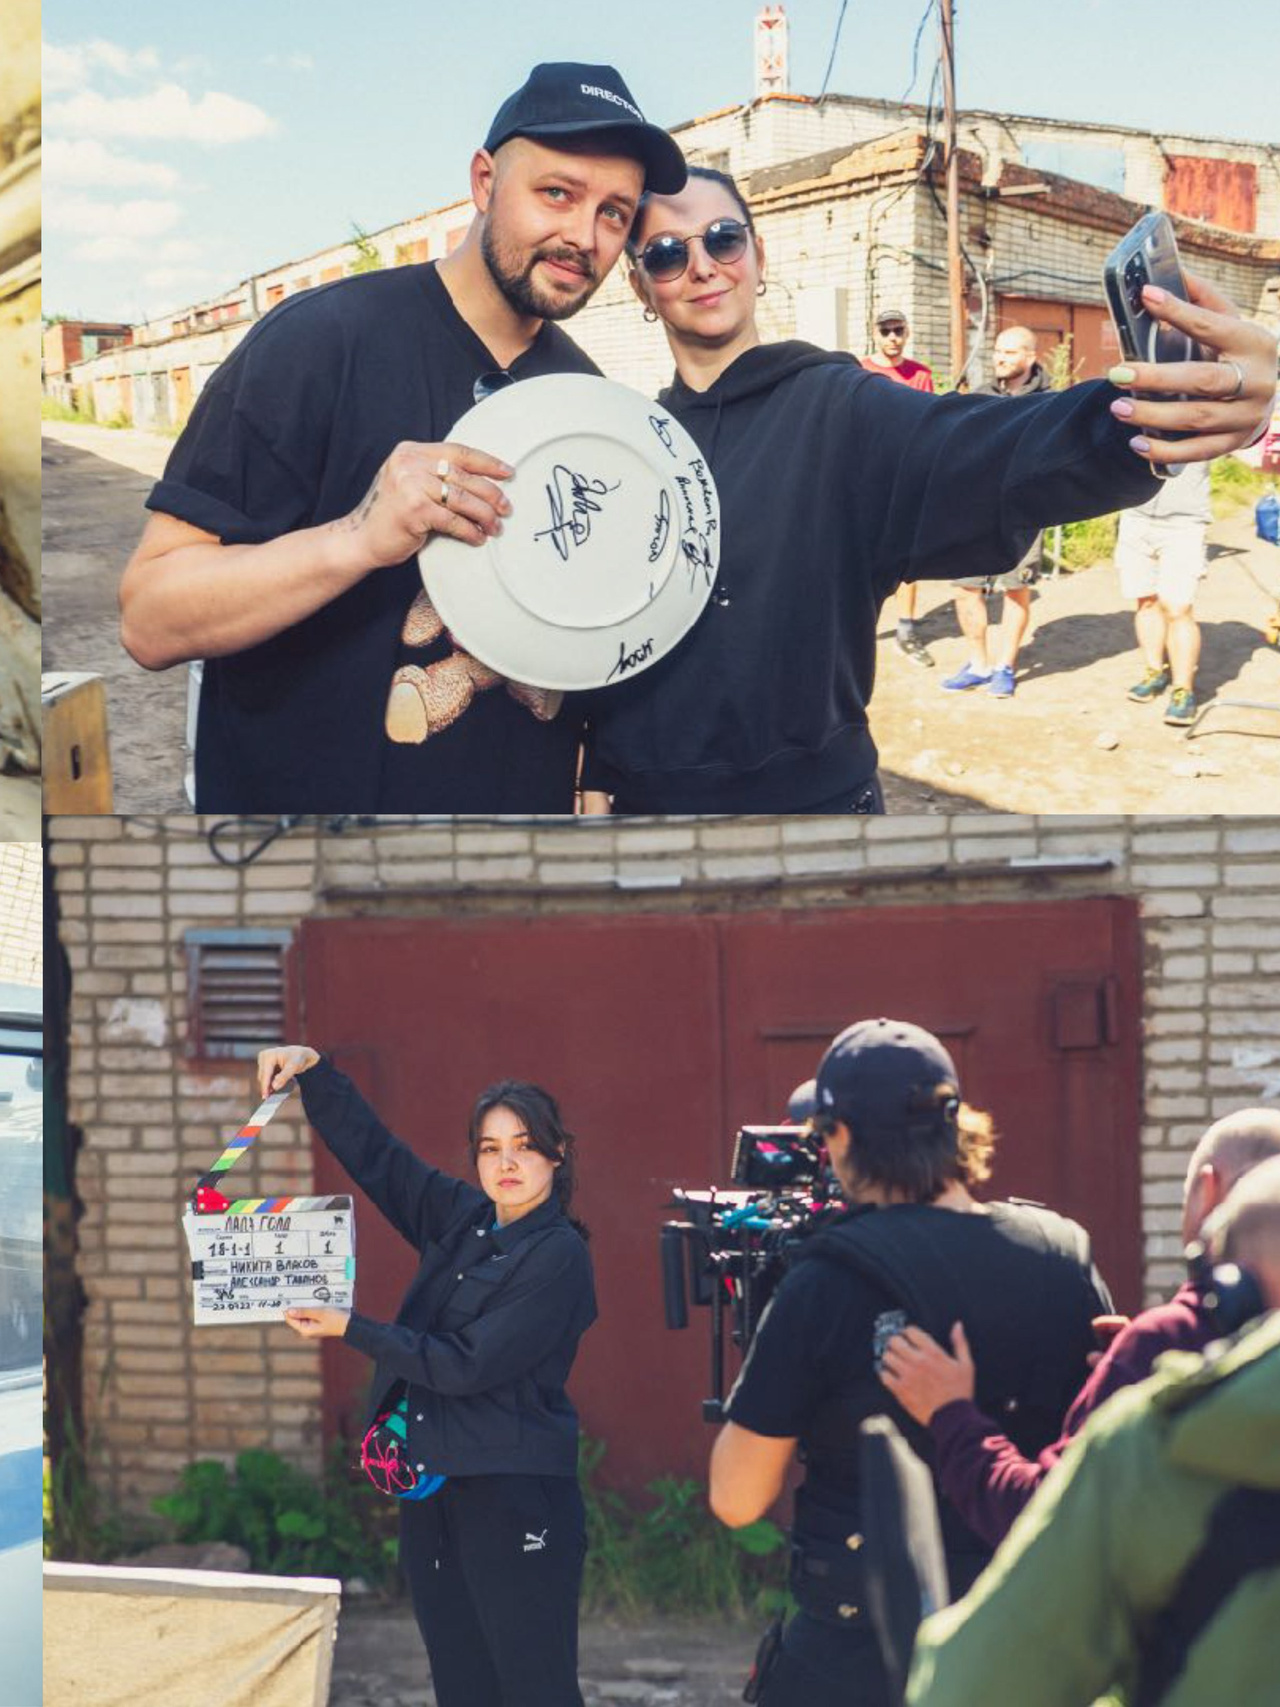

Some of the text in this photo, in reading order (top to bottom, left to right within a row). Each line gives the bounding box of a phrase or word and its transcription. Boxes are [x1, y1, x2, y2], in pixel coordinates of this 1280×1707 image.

[274, 1240, 285, 1255] 1
[323, 1240, 334, 1255] 1
[230, 1260, 272, 1274] НИКИТА
